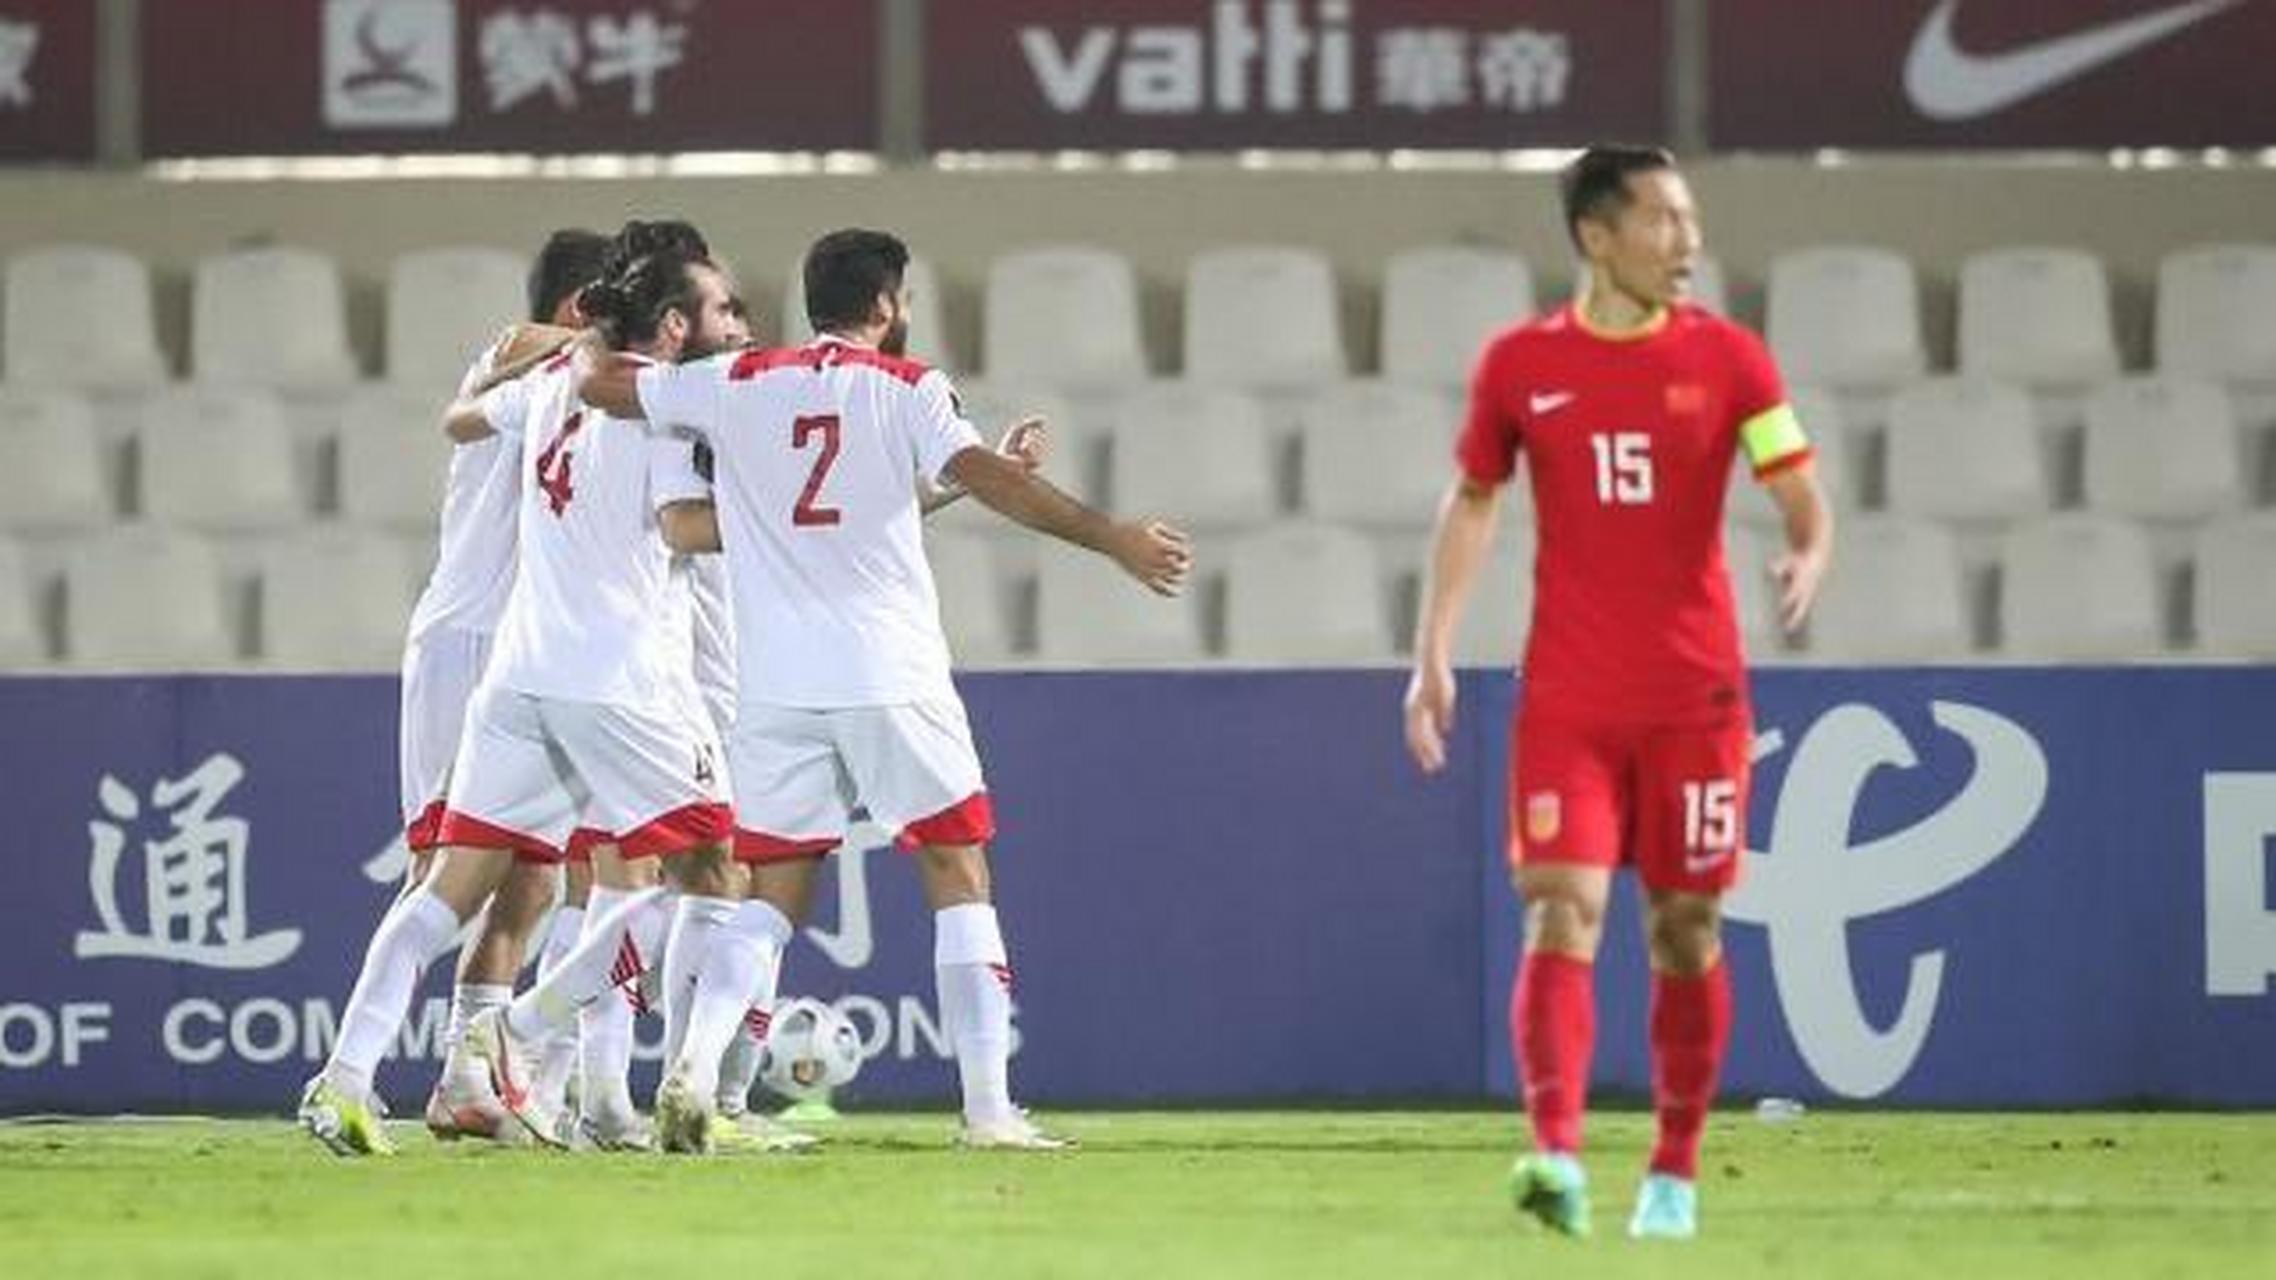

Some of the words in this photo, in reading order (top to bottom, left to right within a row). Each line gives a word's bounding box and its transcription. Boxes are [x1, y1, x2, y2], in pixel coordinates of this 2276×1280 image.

[1018, 0, 1352, 112] vatti
[536, 411, 581, 518] 4
[792, 415, 842, 526] 2
[1593, 433, 1653, 503] 15
[1684, 781, 1735, 847] 15
[0, 1002, 111, 1067] OF
